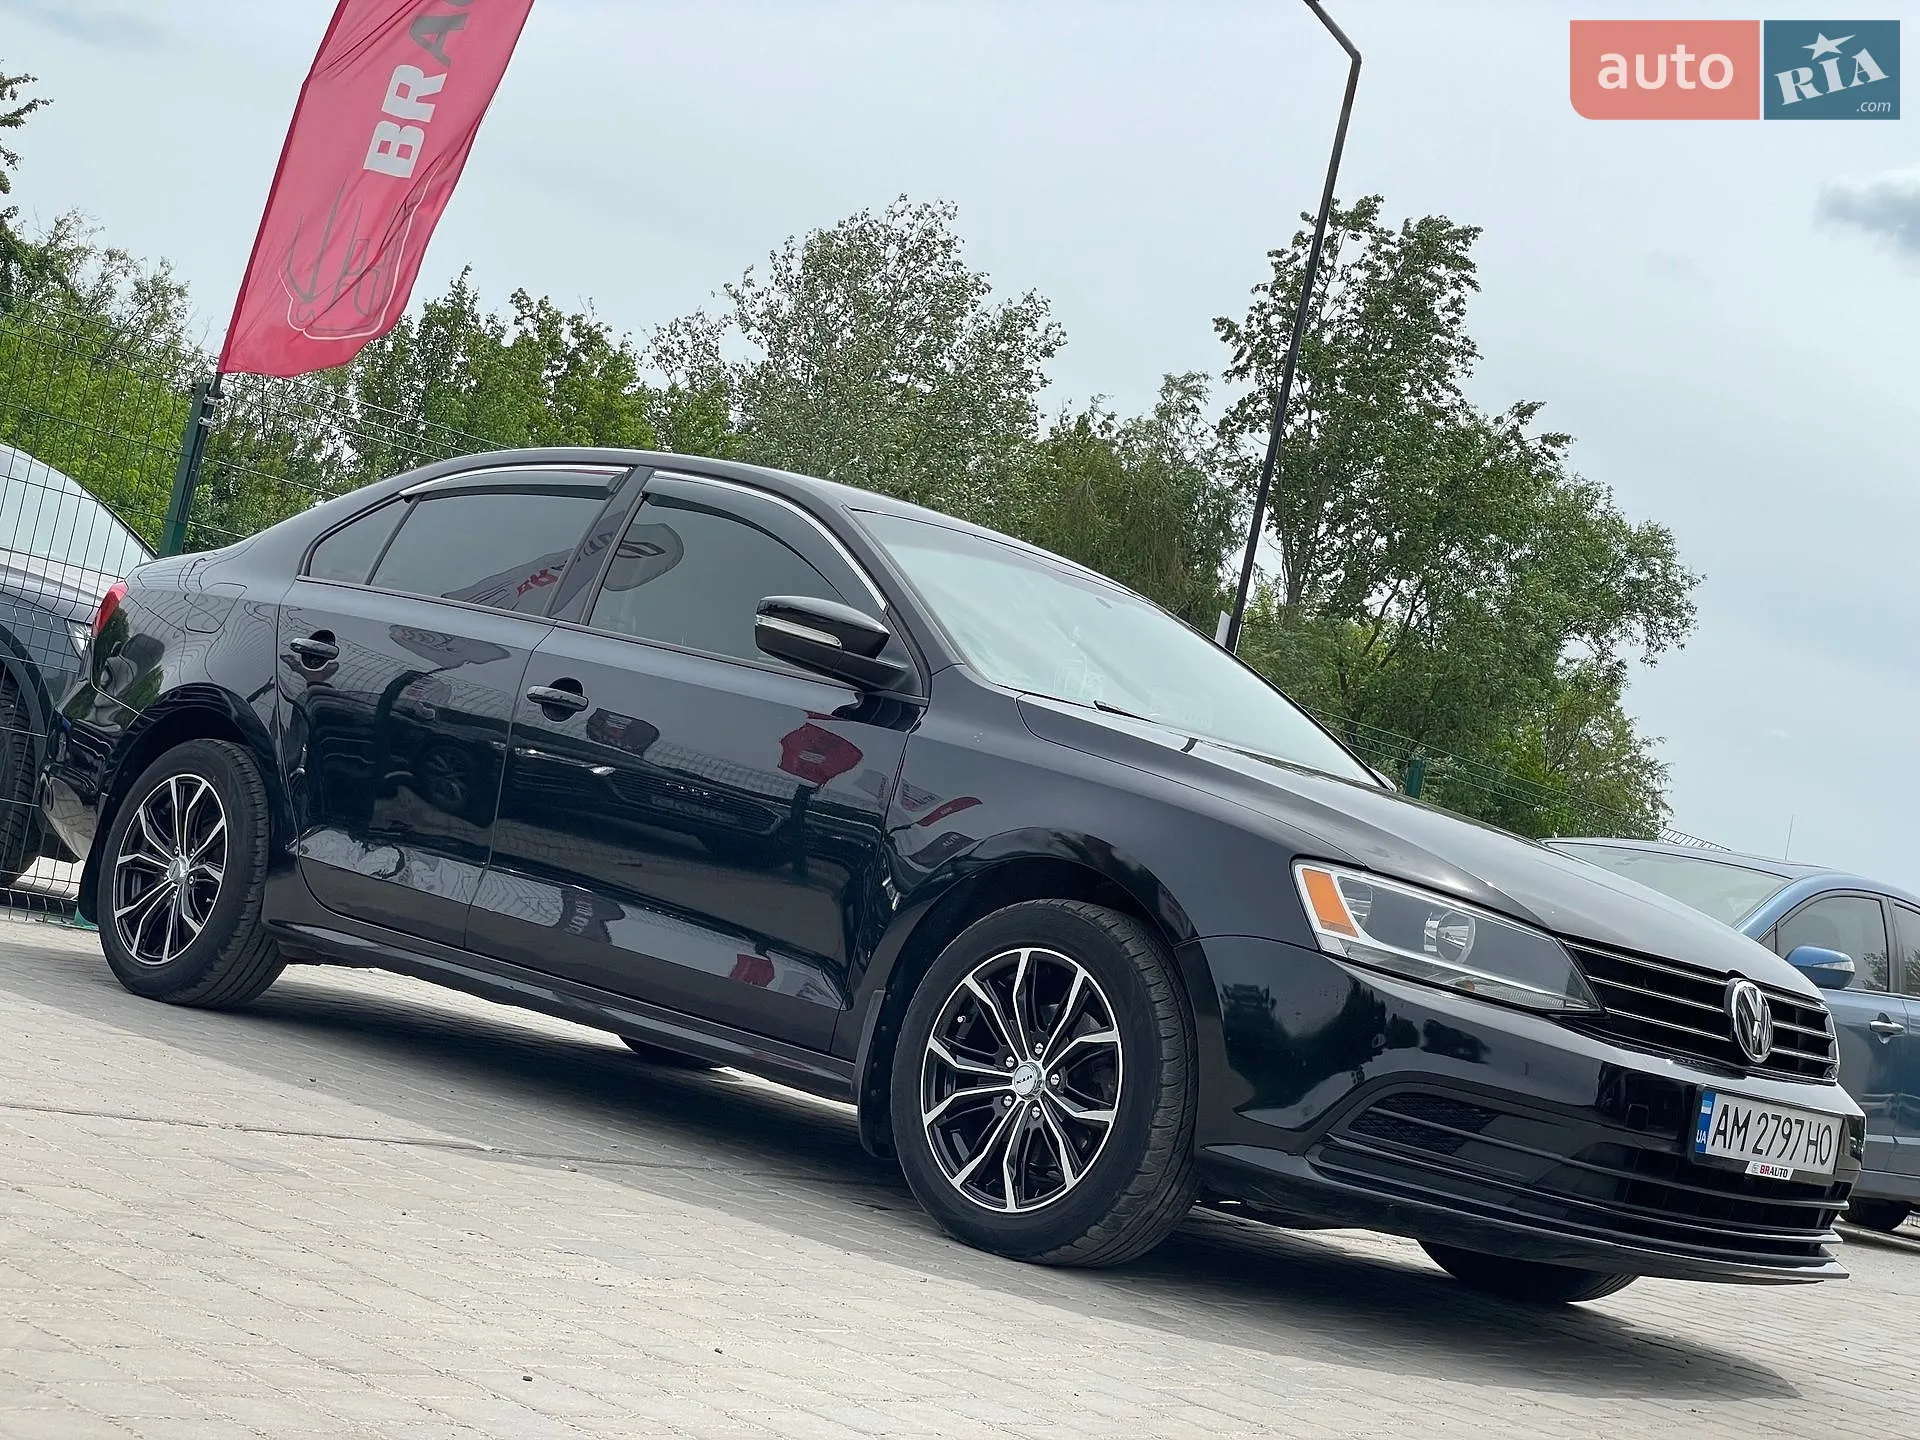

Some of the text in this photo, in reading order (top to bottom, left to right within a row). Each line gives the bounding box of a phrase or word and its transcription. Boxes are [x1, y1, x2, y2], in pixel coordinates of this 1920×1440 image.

[363, 0, 474, 178] BRA
[1695, 1129, 1707, 1144] UA
[1711, 1103, 1832, 1166] AM 2797 HO
[1759, 1164, 1789, 1178] BRAUTO
